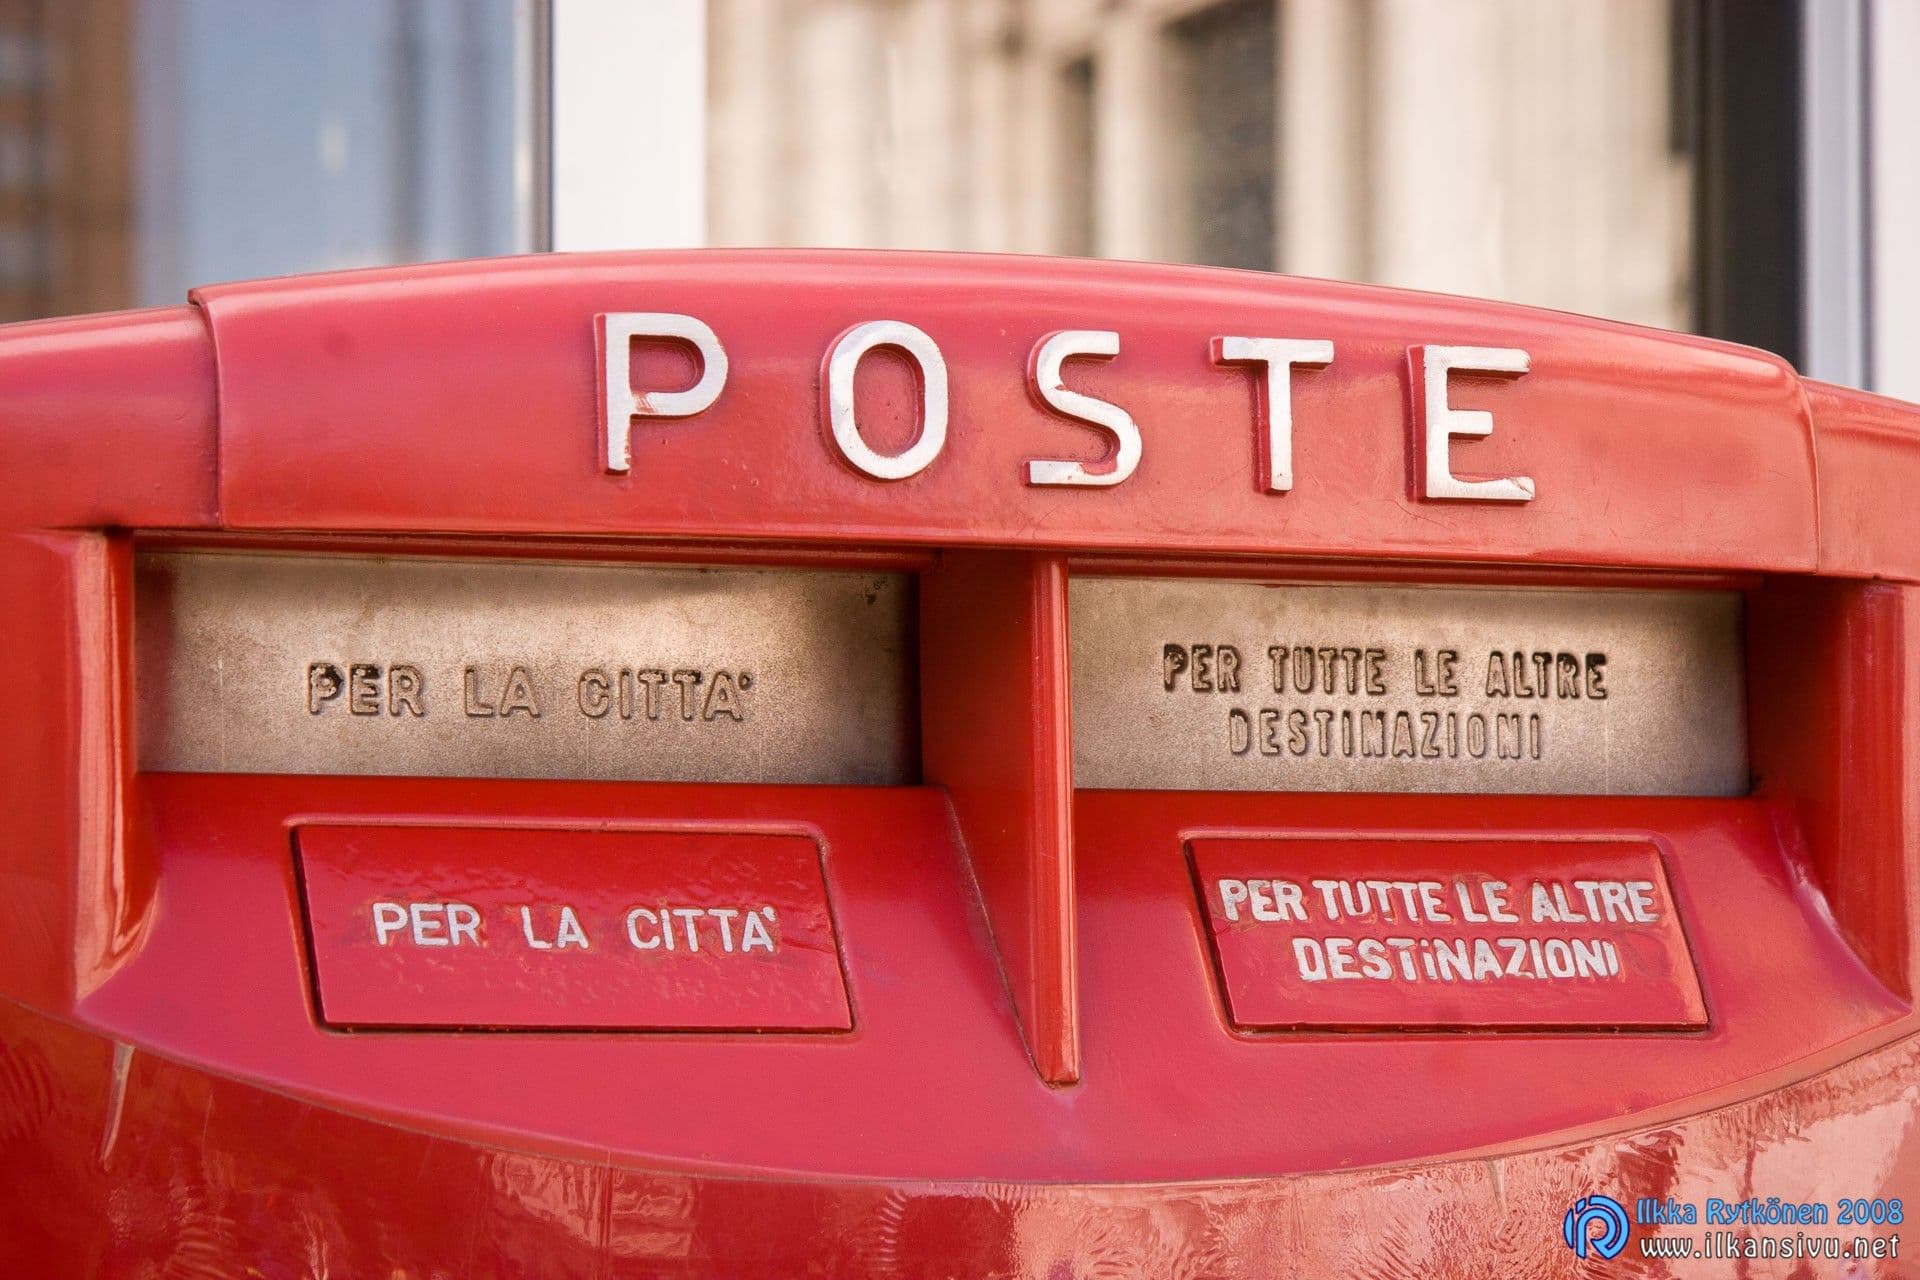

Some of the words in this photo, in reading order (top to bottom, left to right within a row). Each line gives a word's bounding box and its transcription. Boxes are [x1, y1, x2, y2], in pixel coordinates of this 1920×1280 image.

[594, 310, 1537, 504] POSTE
[307, 662, 424, 717] PER
[464, 665, 541, 718] LA
[1163, 643, 1241, 692] PER
[1268, 645, 1388, 695] TUTTE
[1415, 648, 1459, 696] LE
[1486, 651, 1608, 700] ALTRE
[1228, 708, 1541, 760] DESTINAZIONI
[372, 902, 483, 949] PER
[521, 905, 591, 950] LA
[1219, 879, 1308, 922] PER
[1313, 879, 1453, 923] TUTTE
[1456, 881, 1519, 923] LE
[1531, 881, 1661, 923] ALTRE
